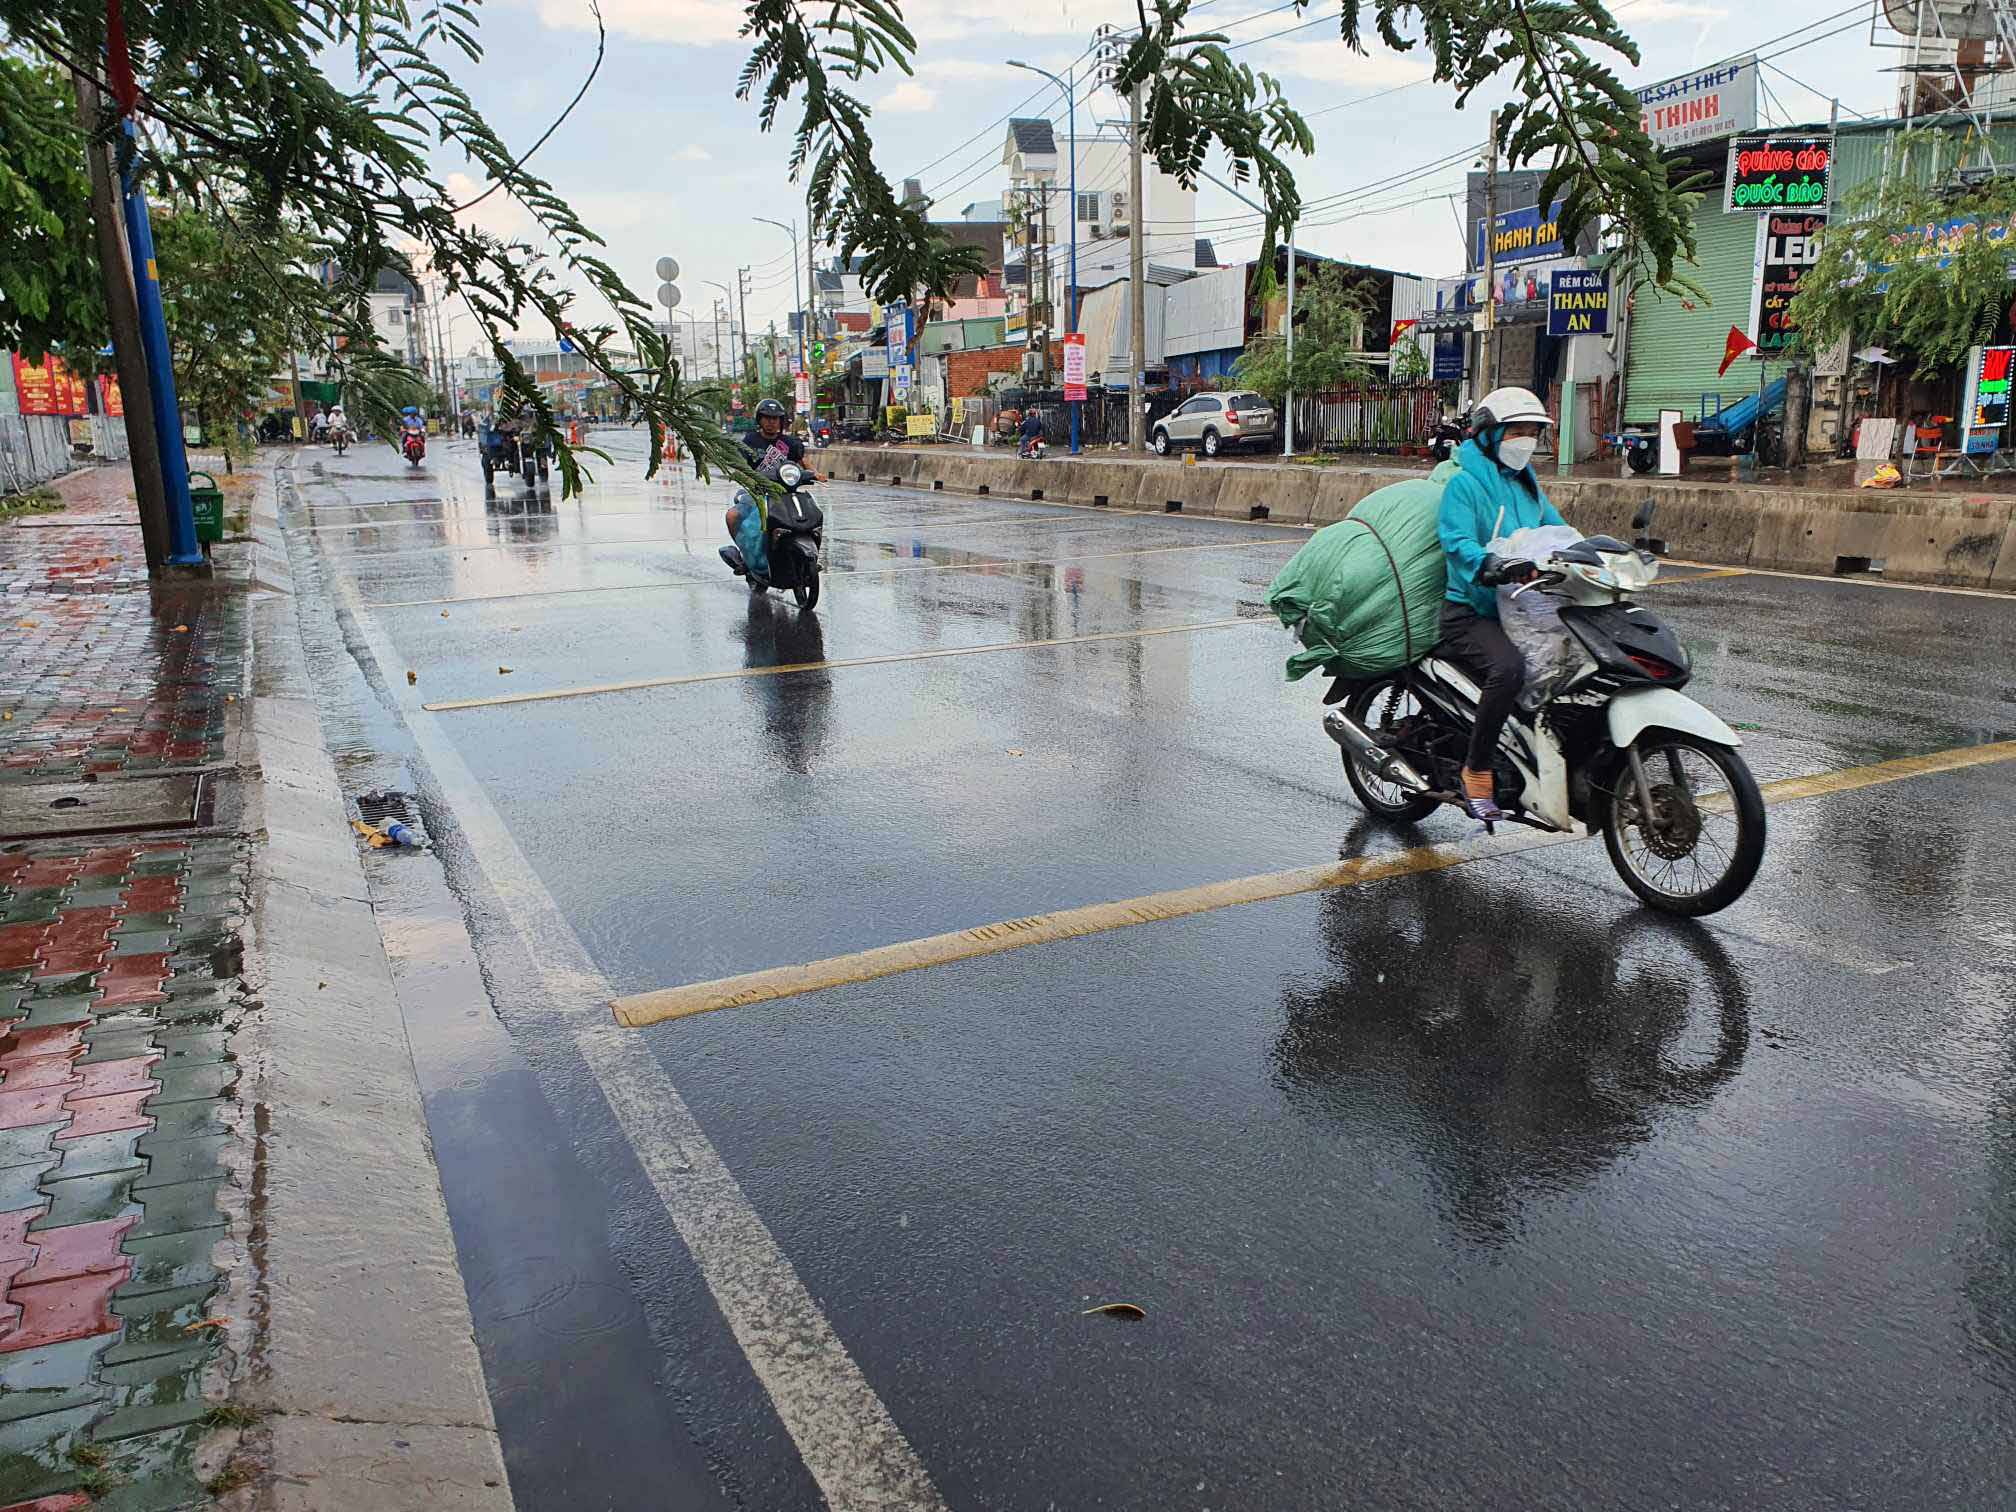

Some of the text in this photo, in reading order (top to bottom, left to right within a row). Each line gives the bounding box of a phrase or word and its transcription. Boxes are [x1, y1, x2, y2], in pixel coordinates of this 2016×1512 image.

[1653, 94, 1719, 131] THỊNH
[1738, 143, 1827, 177] QUẢNG CÁO
[1735, 173, 1823, 206] QUỐC BẢO
[1494, 221, 1558, 253] HANH AN
[1767, 236, 1823, 266] LED
[1559, 273, 1603, 288] RÈM CỬA
[1553, 292, 1608, 310] THANH
[1567, 314, 1592, 331] AN
